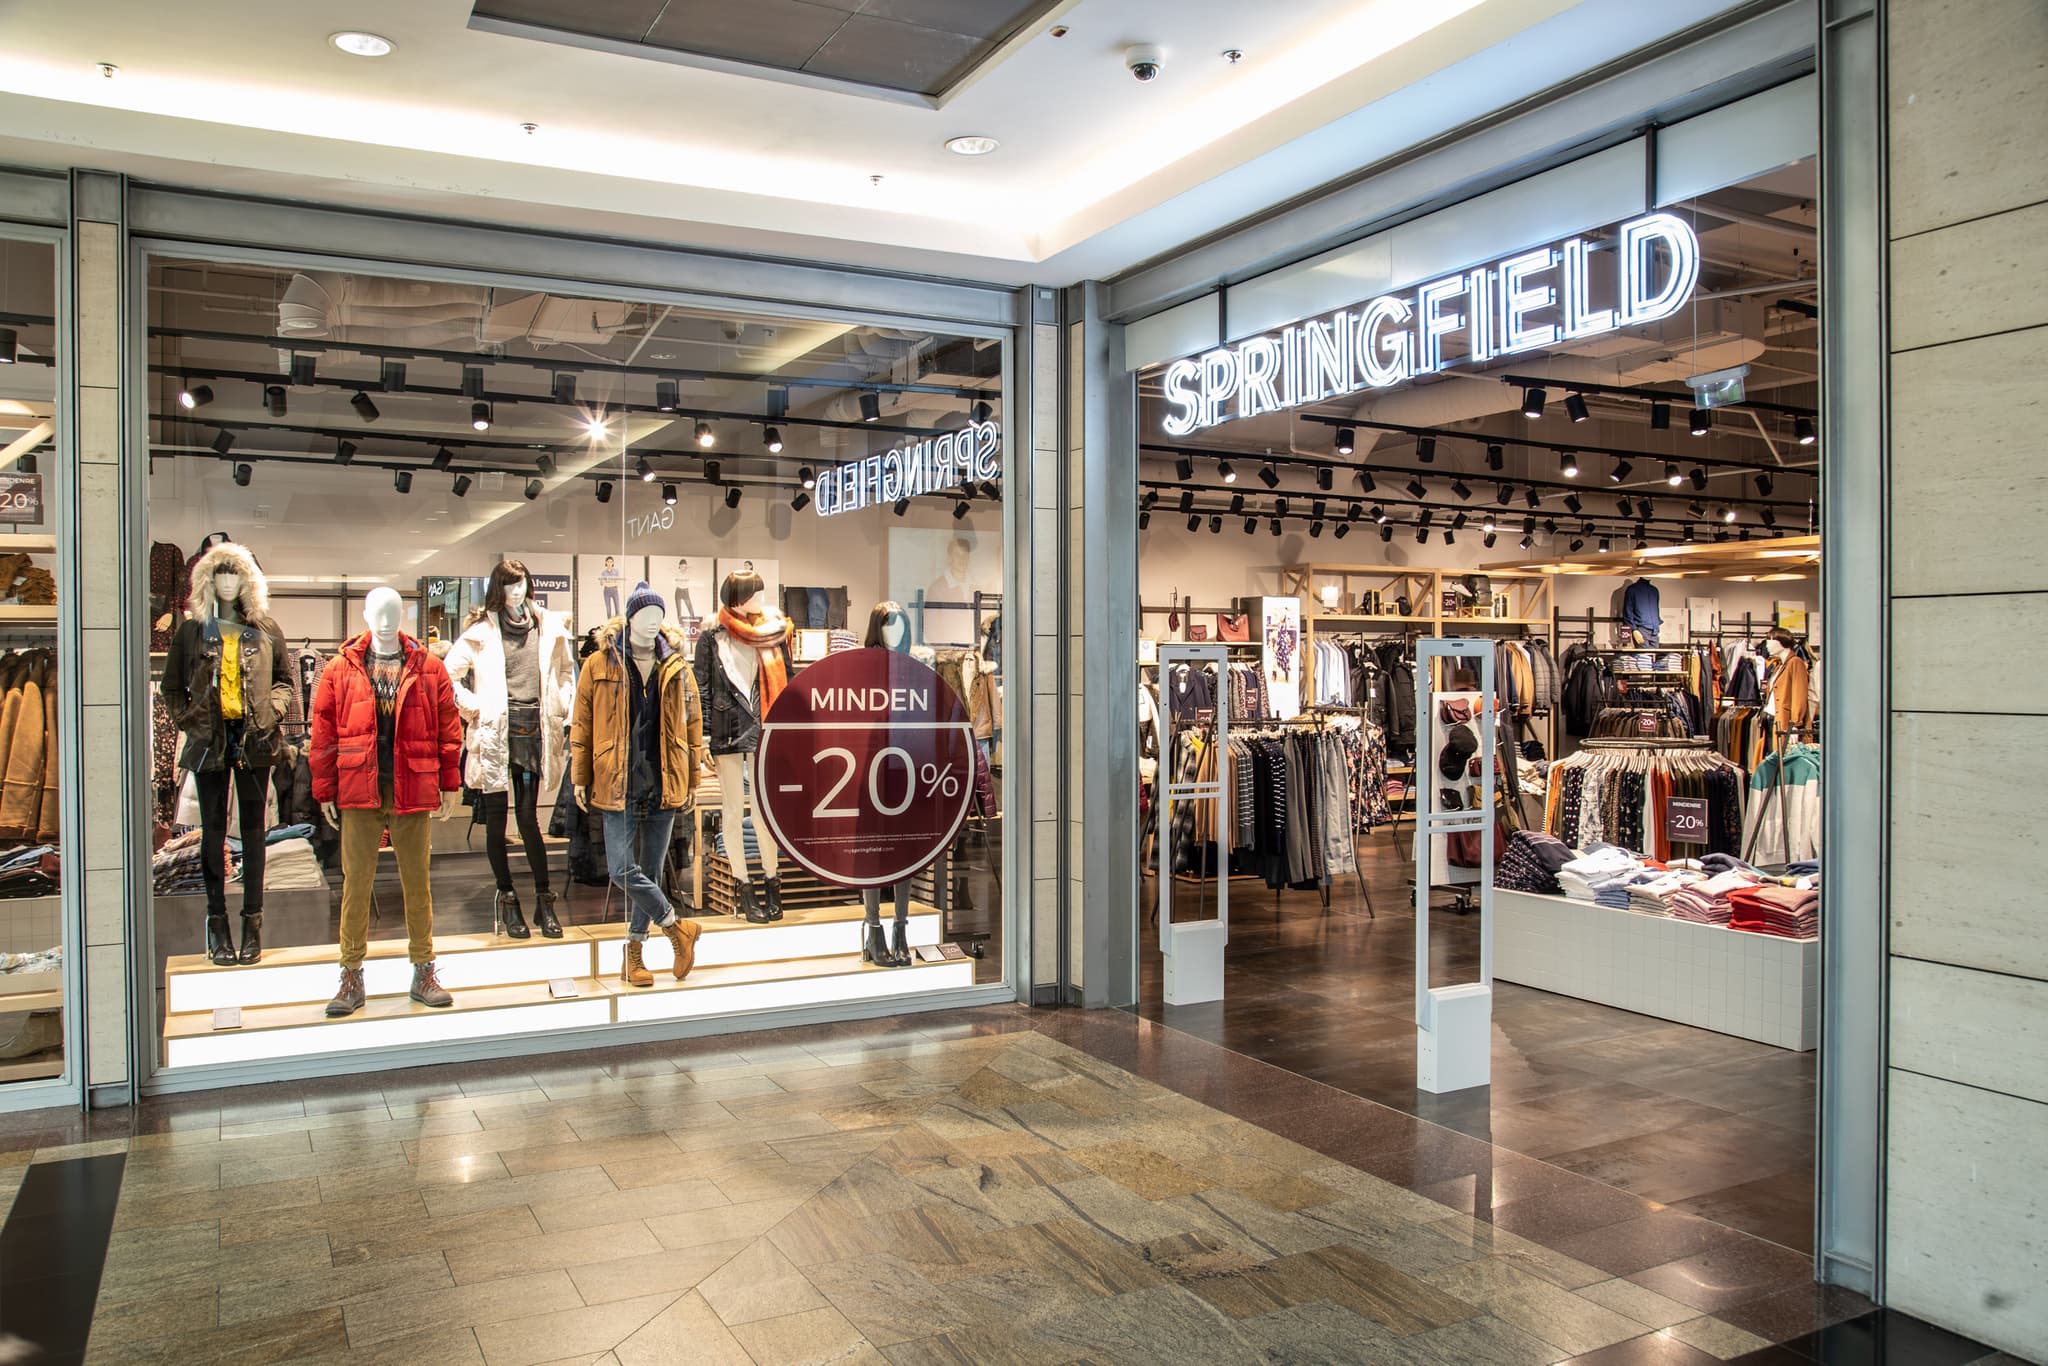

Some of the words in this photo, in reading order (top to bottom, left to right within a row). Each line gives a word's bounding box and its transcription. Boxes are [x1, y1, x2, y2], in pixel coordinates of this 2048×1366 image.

[1162, 211, 1700, 436] SPRINGFIELD
[811, 688, 928, 711] MINDEN
[779, 746, 959, 818] -20%
[1670, 815, 1704, 829] -20%
